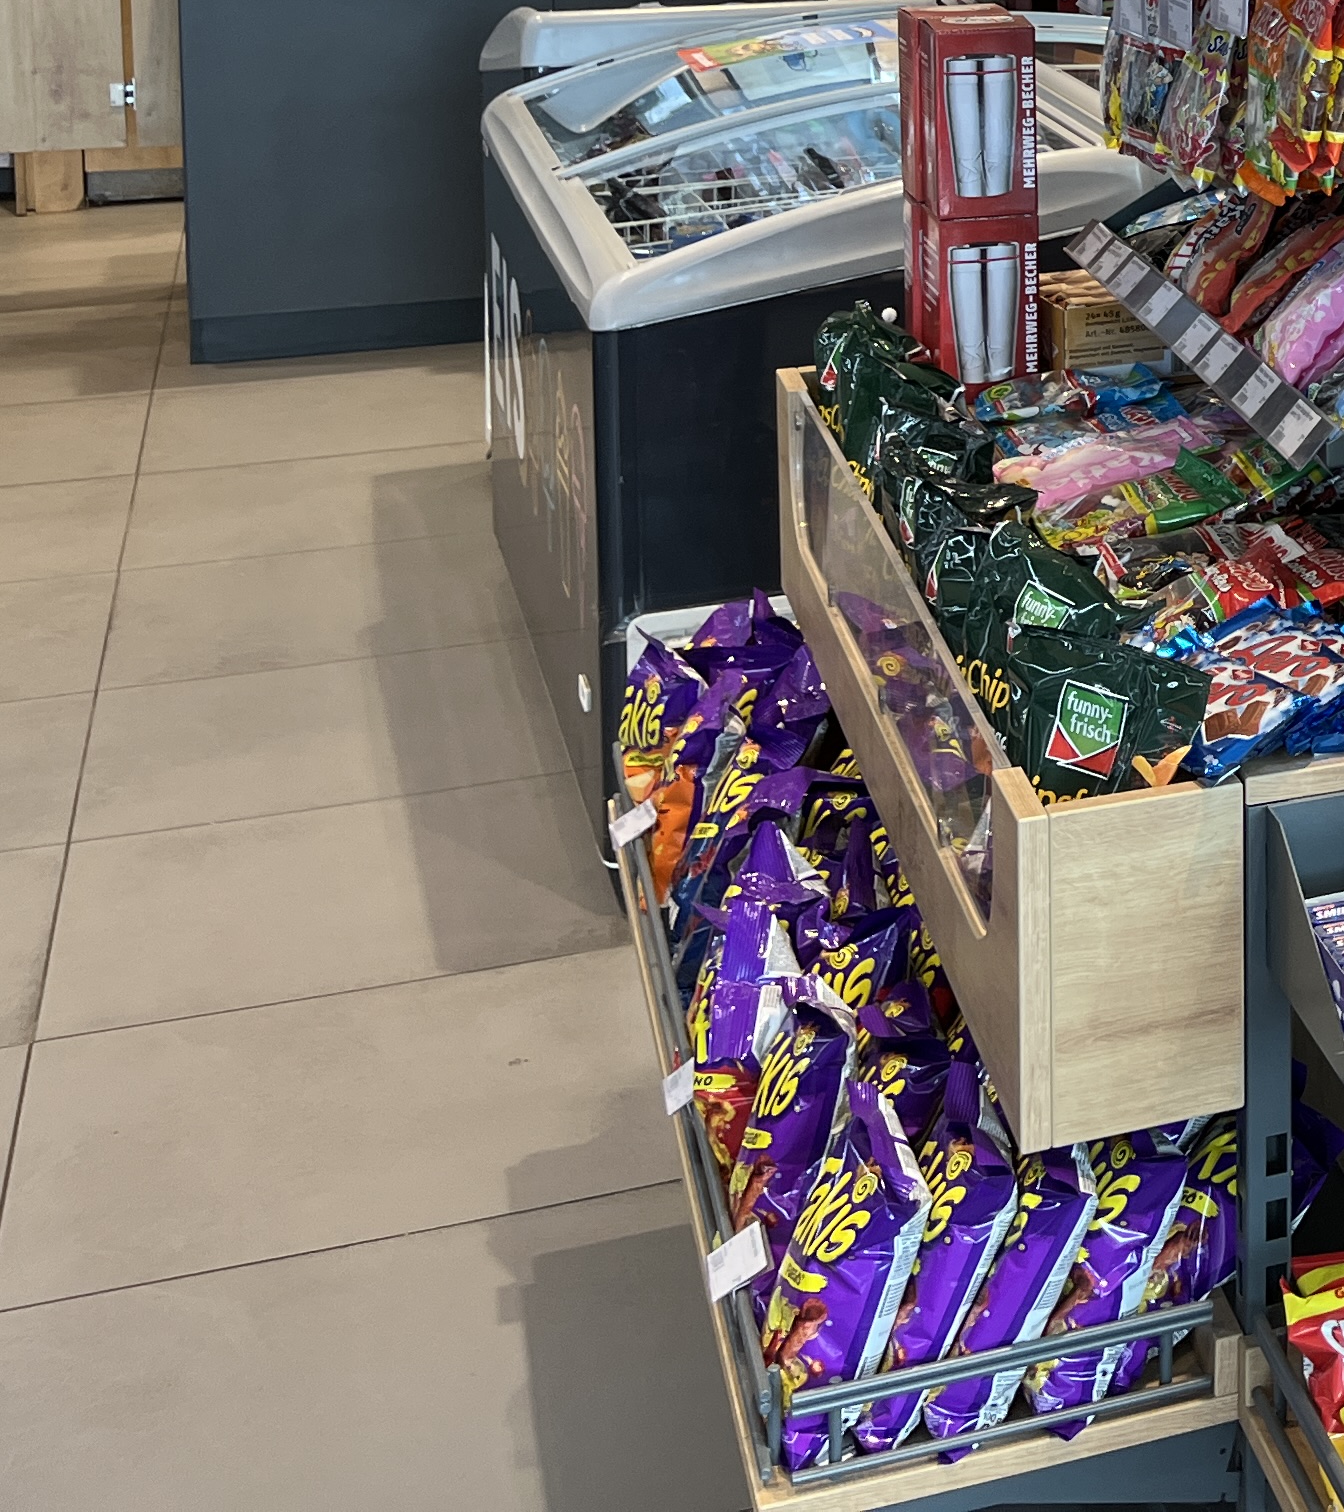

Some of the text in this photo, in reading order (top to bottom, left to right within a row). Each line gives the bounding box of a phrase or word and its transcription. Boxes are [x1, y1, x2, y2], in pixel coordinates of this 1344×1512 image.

[1021, 56, 1035, 189] MEHRWEG-BECHER
[1025, 243, 1038, 374] MEHRWEG-BECHER
[1066, 690, 1113, 720] funny-
[1070, 717, 1111, 743] frisch
